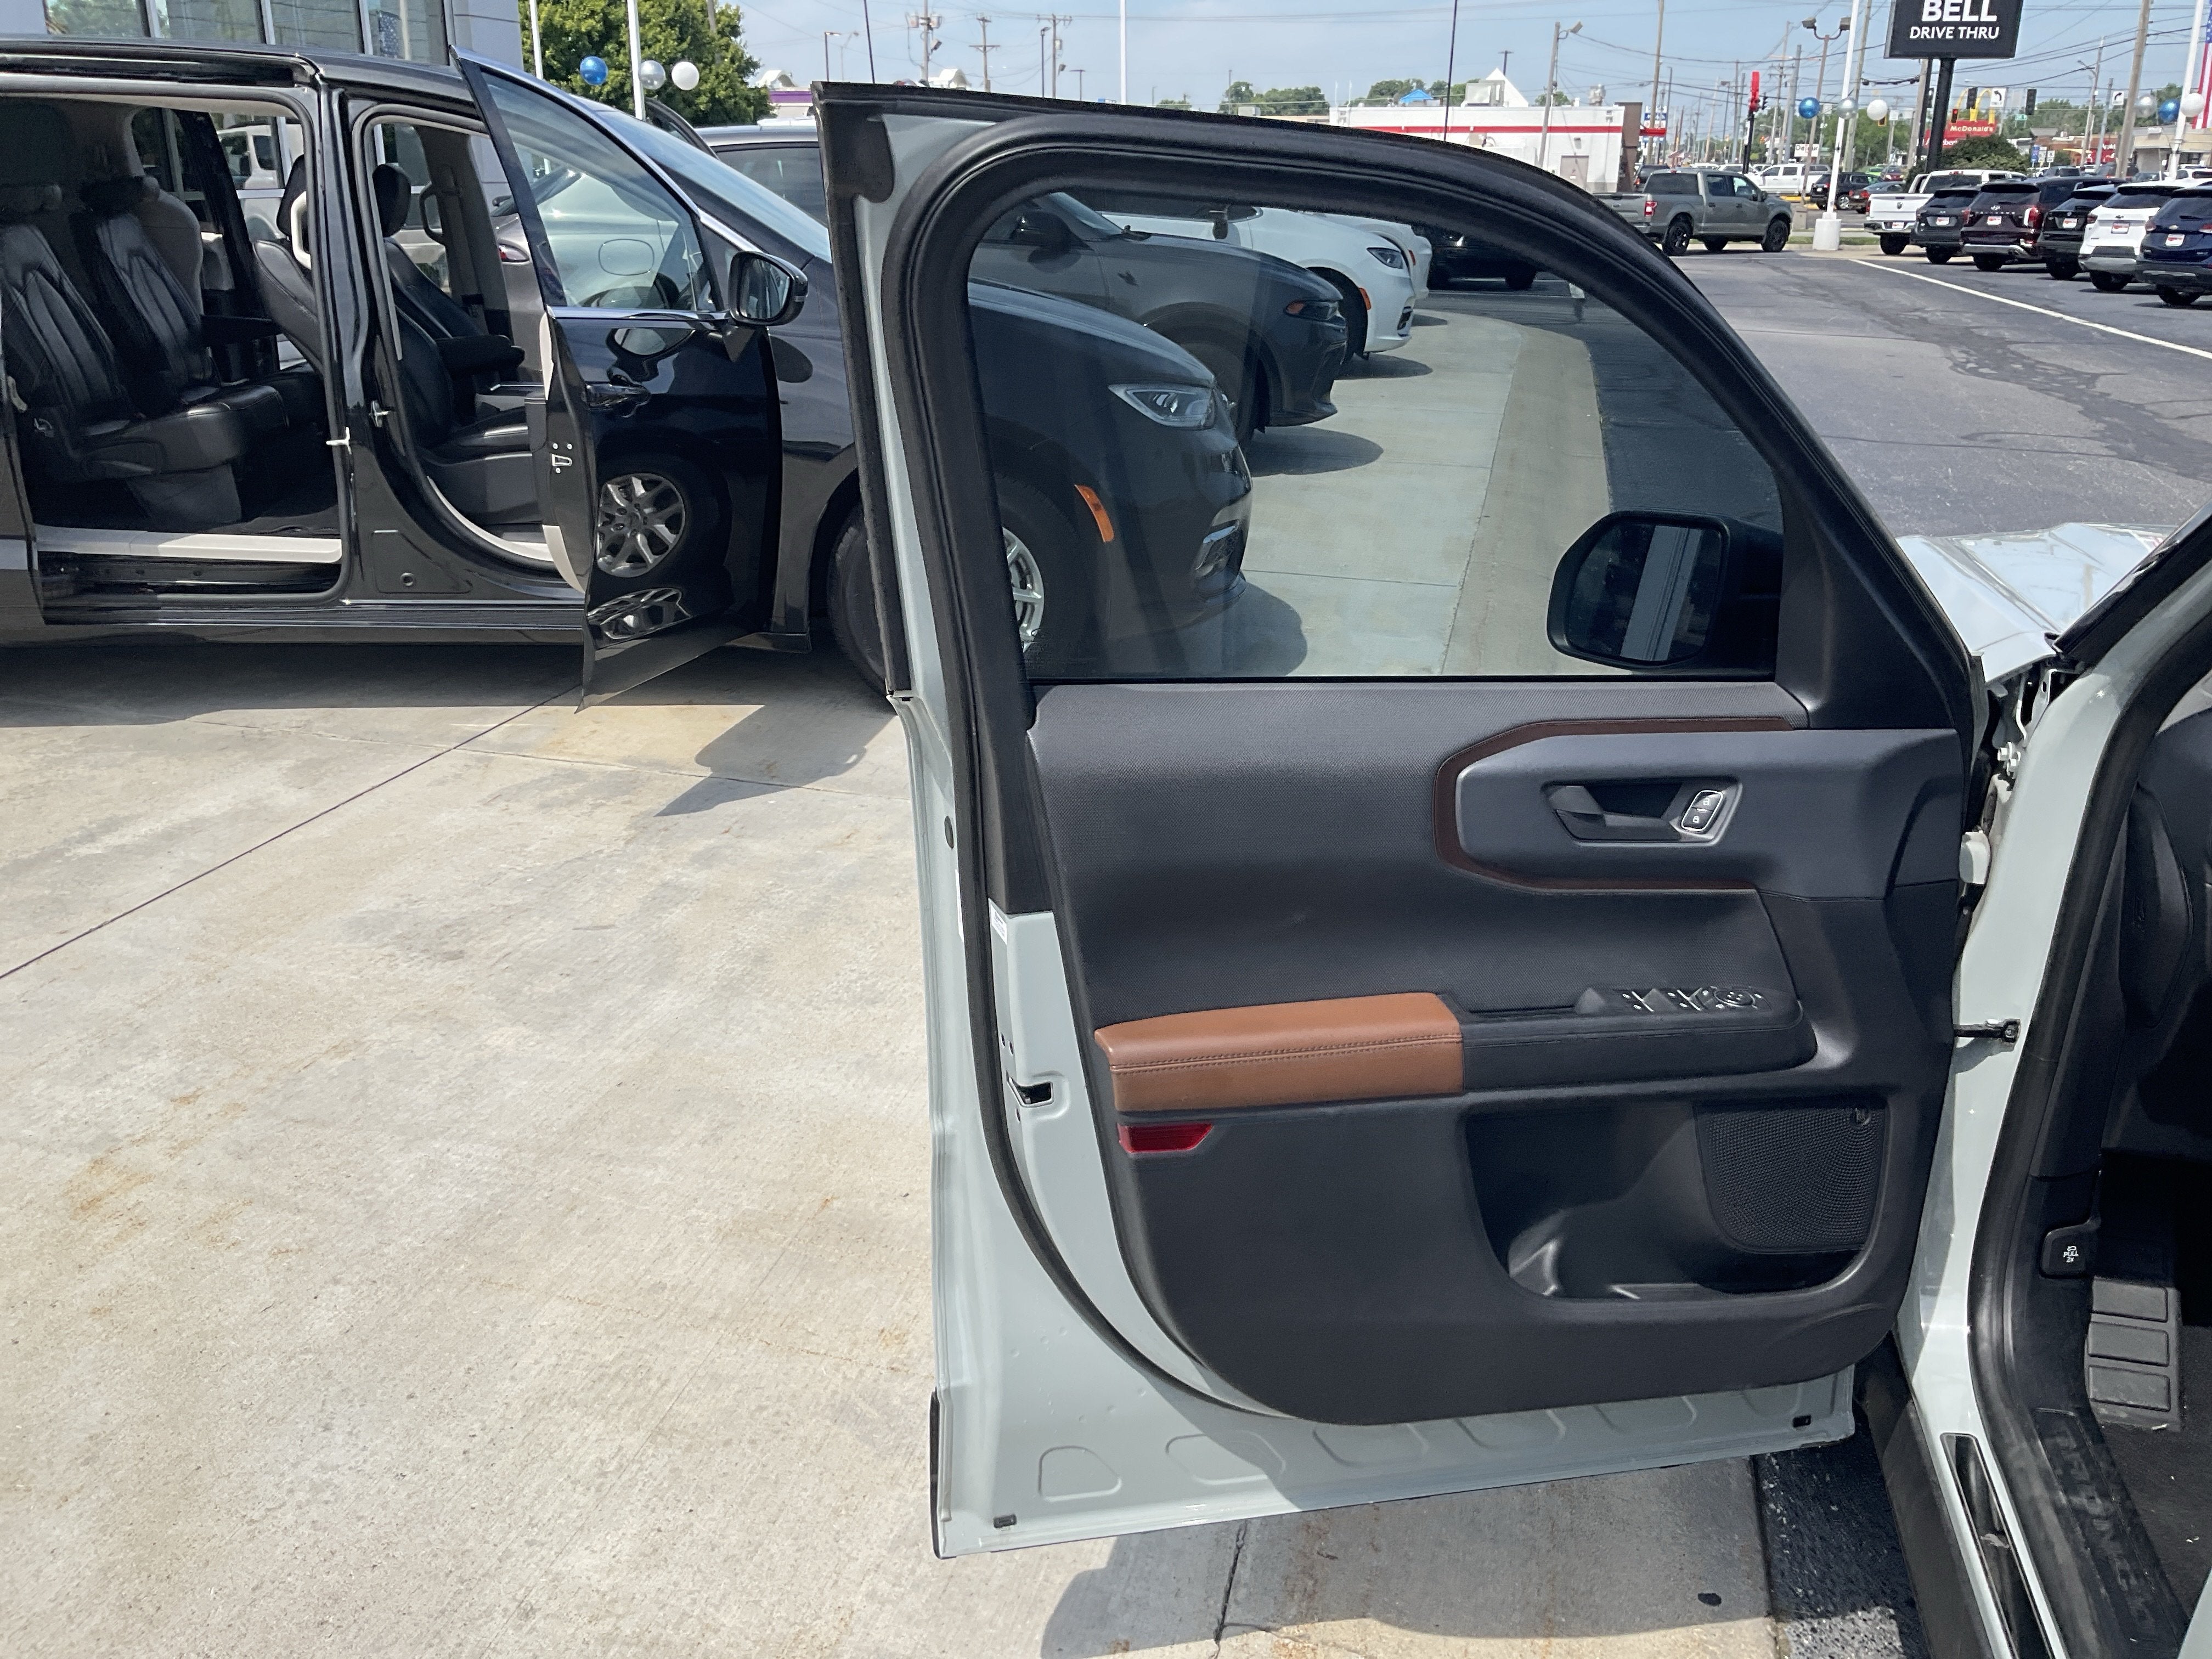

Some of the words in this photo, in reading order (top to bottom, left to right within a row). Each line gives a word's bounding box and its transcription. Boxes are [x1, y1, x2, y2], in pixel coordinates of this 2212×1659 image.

[1922, 0, 1997, 22] BELL
[1909, 26, 1954, 39] DRIVE
[1958, 26, 2000, 40] THRU
